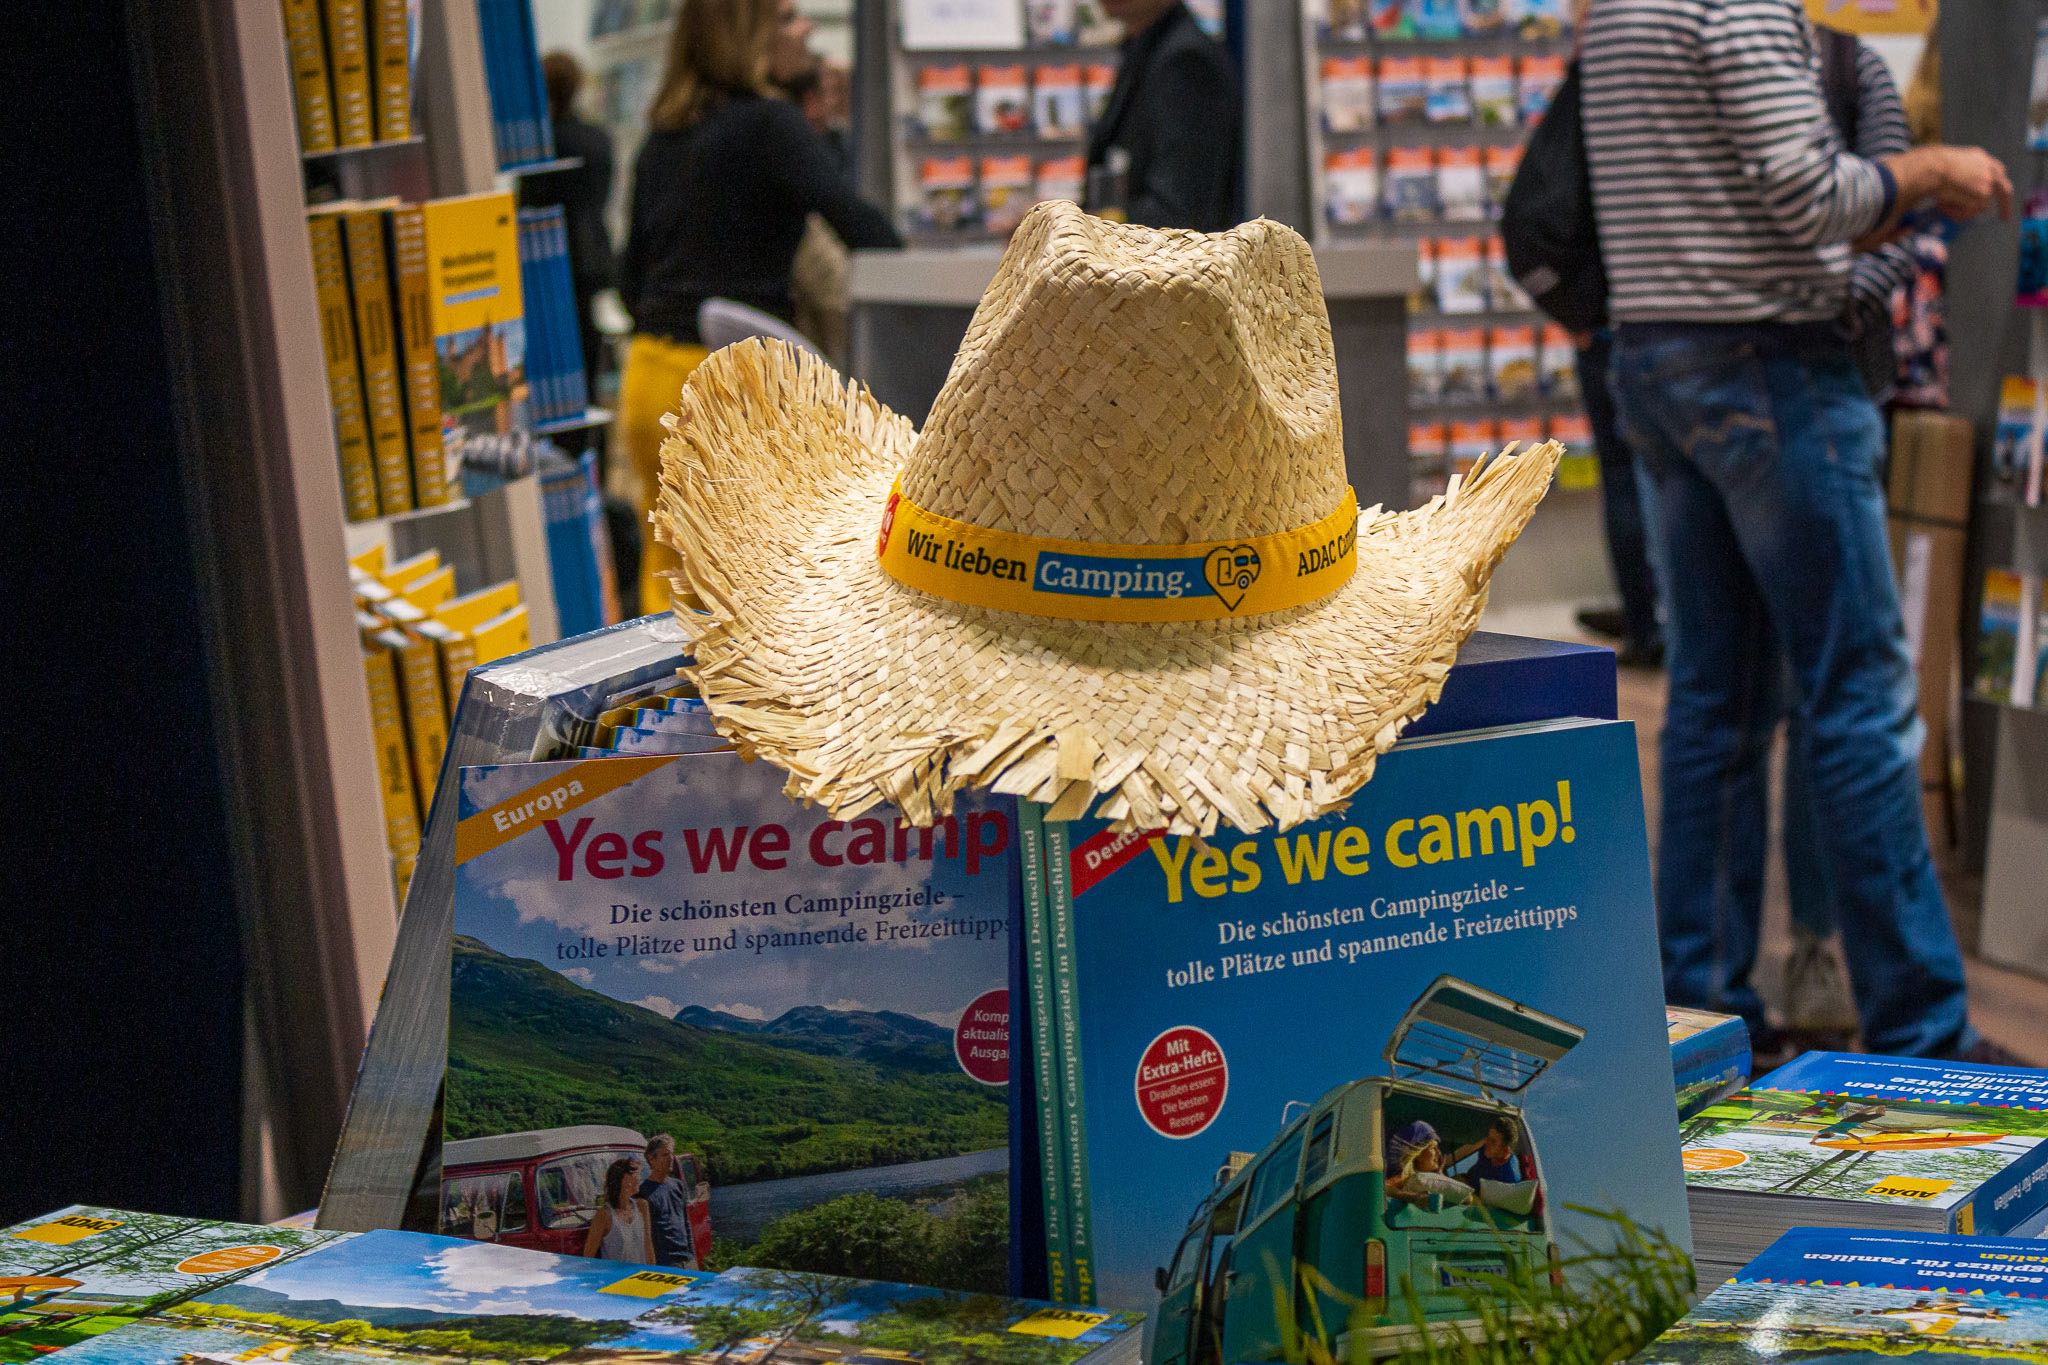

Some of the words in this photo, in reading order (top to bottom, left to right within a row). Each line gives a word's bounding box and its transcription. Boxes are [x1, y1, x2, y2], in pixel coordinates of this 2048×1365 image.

[907, 528, 942, 563] Wir
[945, 540, 1028, 582] lieben
[1040, 560, 1192, 599] Camping.
[1297, 540, 1336, 577] ADAC
[491, 779, 585, 833] Europa
[541, 817, 664, 882] Yes
[683, 823, 791, 875] we
[808, 809, 1009, 876] camp
[1148, 836, 1262, 903] Yes
[1274, 826, 1370, 885] we
[1385, 780, 1576, 868] camp!
[1024, 829, 1041, 944] Deutschland
[1050, 832, 1067, 948] Deutschland
[610, 903, 652, 925] Die
[659, 898, 777, 923] schönsten
[784, 885, 944, 918] Campingziele
[1218, 920, 1256, 945] Die
[1262, 907, 1365, 938] schönsten
[1370, 879, 1508, 918] Campingziele
[557, 937, 608, 960] tolle
[616, 934, 685, 957] Plätze
[692, 929, 737, 952] und
[745, 922, 867, 955] spannende
[1166, 960, 1215, 988] tolle
[1221, 951, 1286, 979] Plätze
[1292, 939, 1333, 967] und
[1338, 921, 1448, 964] spannende
[1453, 903, 1578, 940] Freizeittipps
[1032, 951, 1042, 968] in
[1058, 954, 1069, 973] in
[1034, 974, 1052, 1102] Campingziele
[1059, 979, 1077, 1107] Campingziele
[1166, 1038, 1190, 1057] Mit
[1143, 1050, 1217, 1081] Extra-Heft:
[1161, 1102, 1178, 1115] Die
[1178, 1095, 1209, 1111] besten
[1844, 1081, 1974, 1097] schönsten
[1869, 1186, 1938, 1198] ADAC
[56, 1216, 118, 1232] ADAC
[1048, 1205, 1059, 1240] Die
[1074, 1212, 1086, 1247] Die
[1803, 1253, 1906, 1266] Familien
[1912, 1258, 1951, 1268] für
[1917, 1269, 2044, 1283] schönsten
[630, 1272, 693, 1286] ADAC
[1039, 1310, 1104, 1324] ADAC
